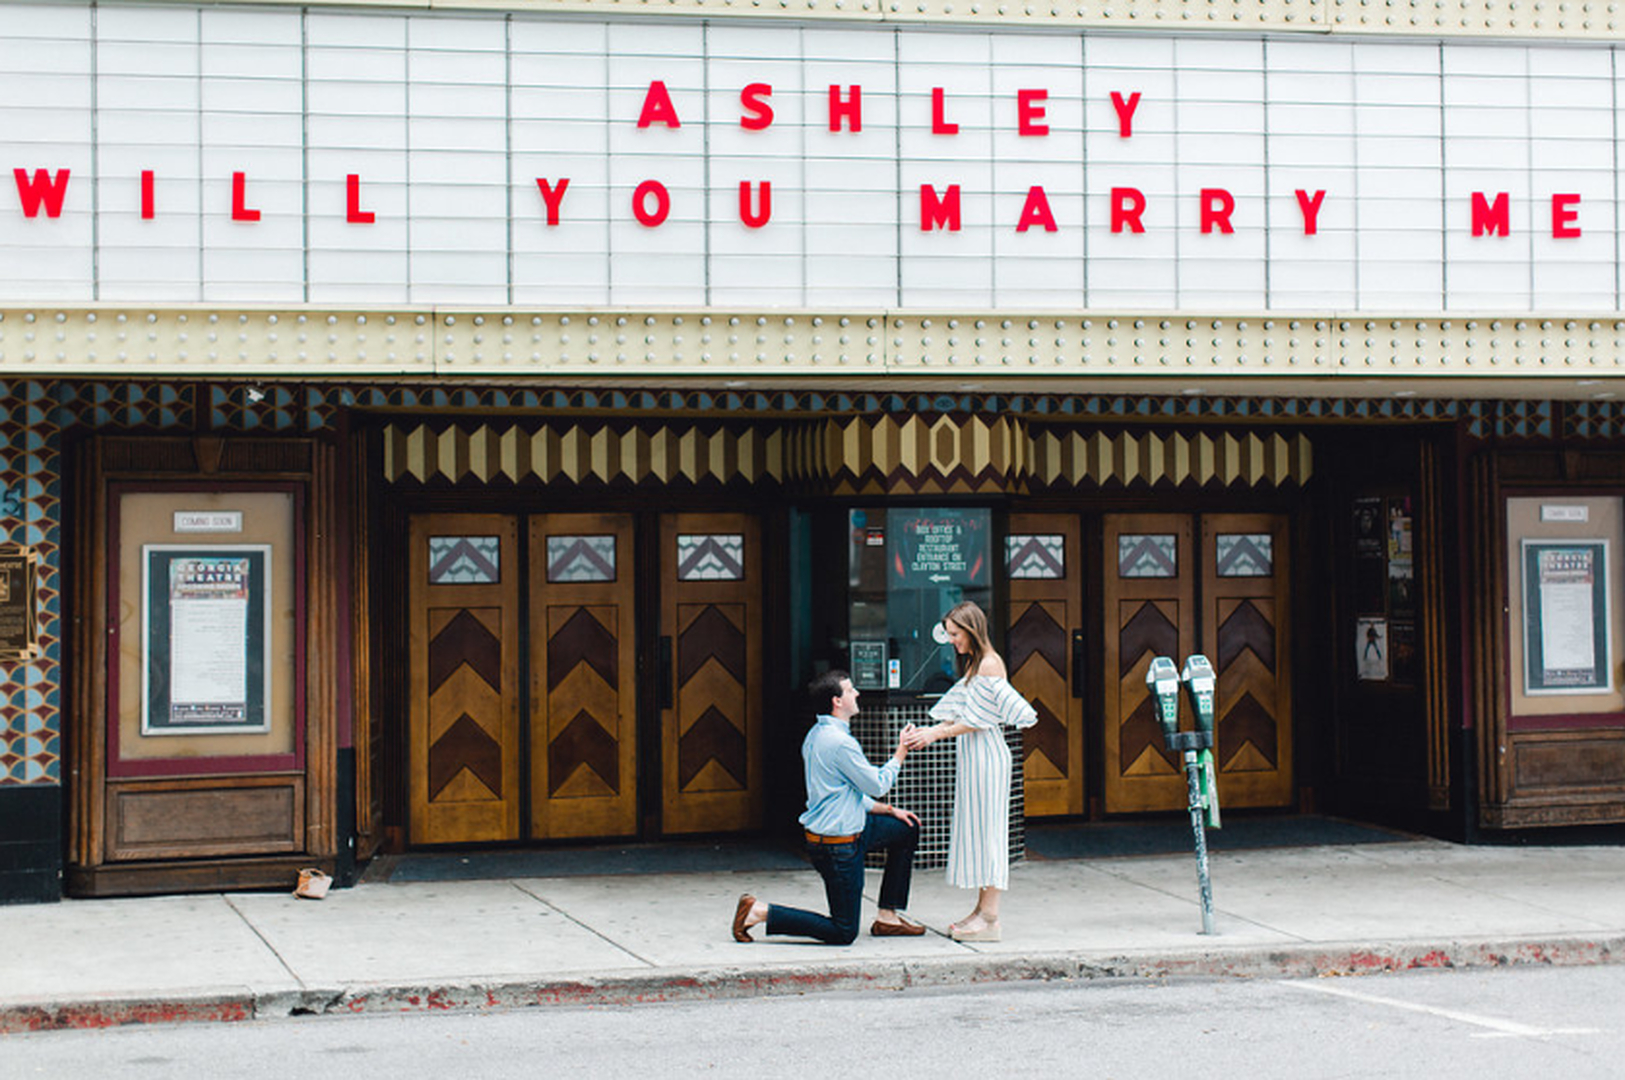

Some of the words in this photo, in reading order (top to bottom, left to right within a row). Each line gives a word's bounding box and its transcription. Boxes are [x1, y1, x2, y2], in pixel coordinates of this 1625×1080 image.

[636, 80, 1142, 138] ASHLEY
[13, 168, 376, 224] WILL
[535, 177, 772, 229] YOU
[919, 184, 1326, 237] MARRY
[1470, 192, 1582, 240] ME
[181, 516, 210, 526] COMING
[212, 516, 234, 526] SOON
[916, 525, 930, 535] BOX
[924, 534, 953, 543] ROOFTOP
[918, 543, 960, 553] RESTAURANT
[916, 552, 950, 562] ENTRANCE
[177, 563, 242, 572] GEORGIA
[911, 561, 941, 571] CLAYTON
[943, 561, 967, 571] STREET
[177, 573, 242, 582] THEATRE
